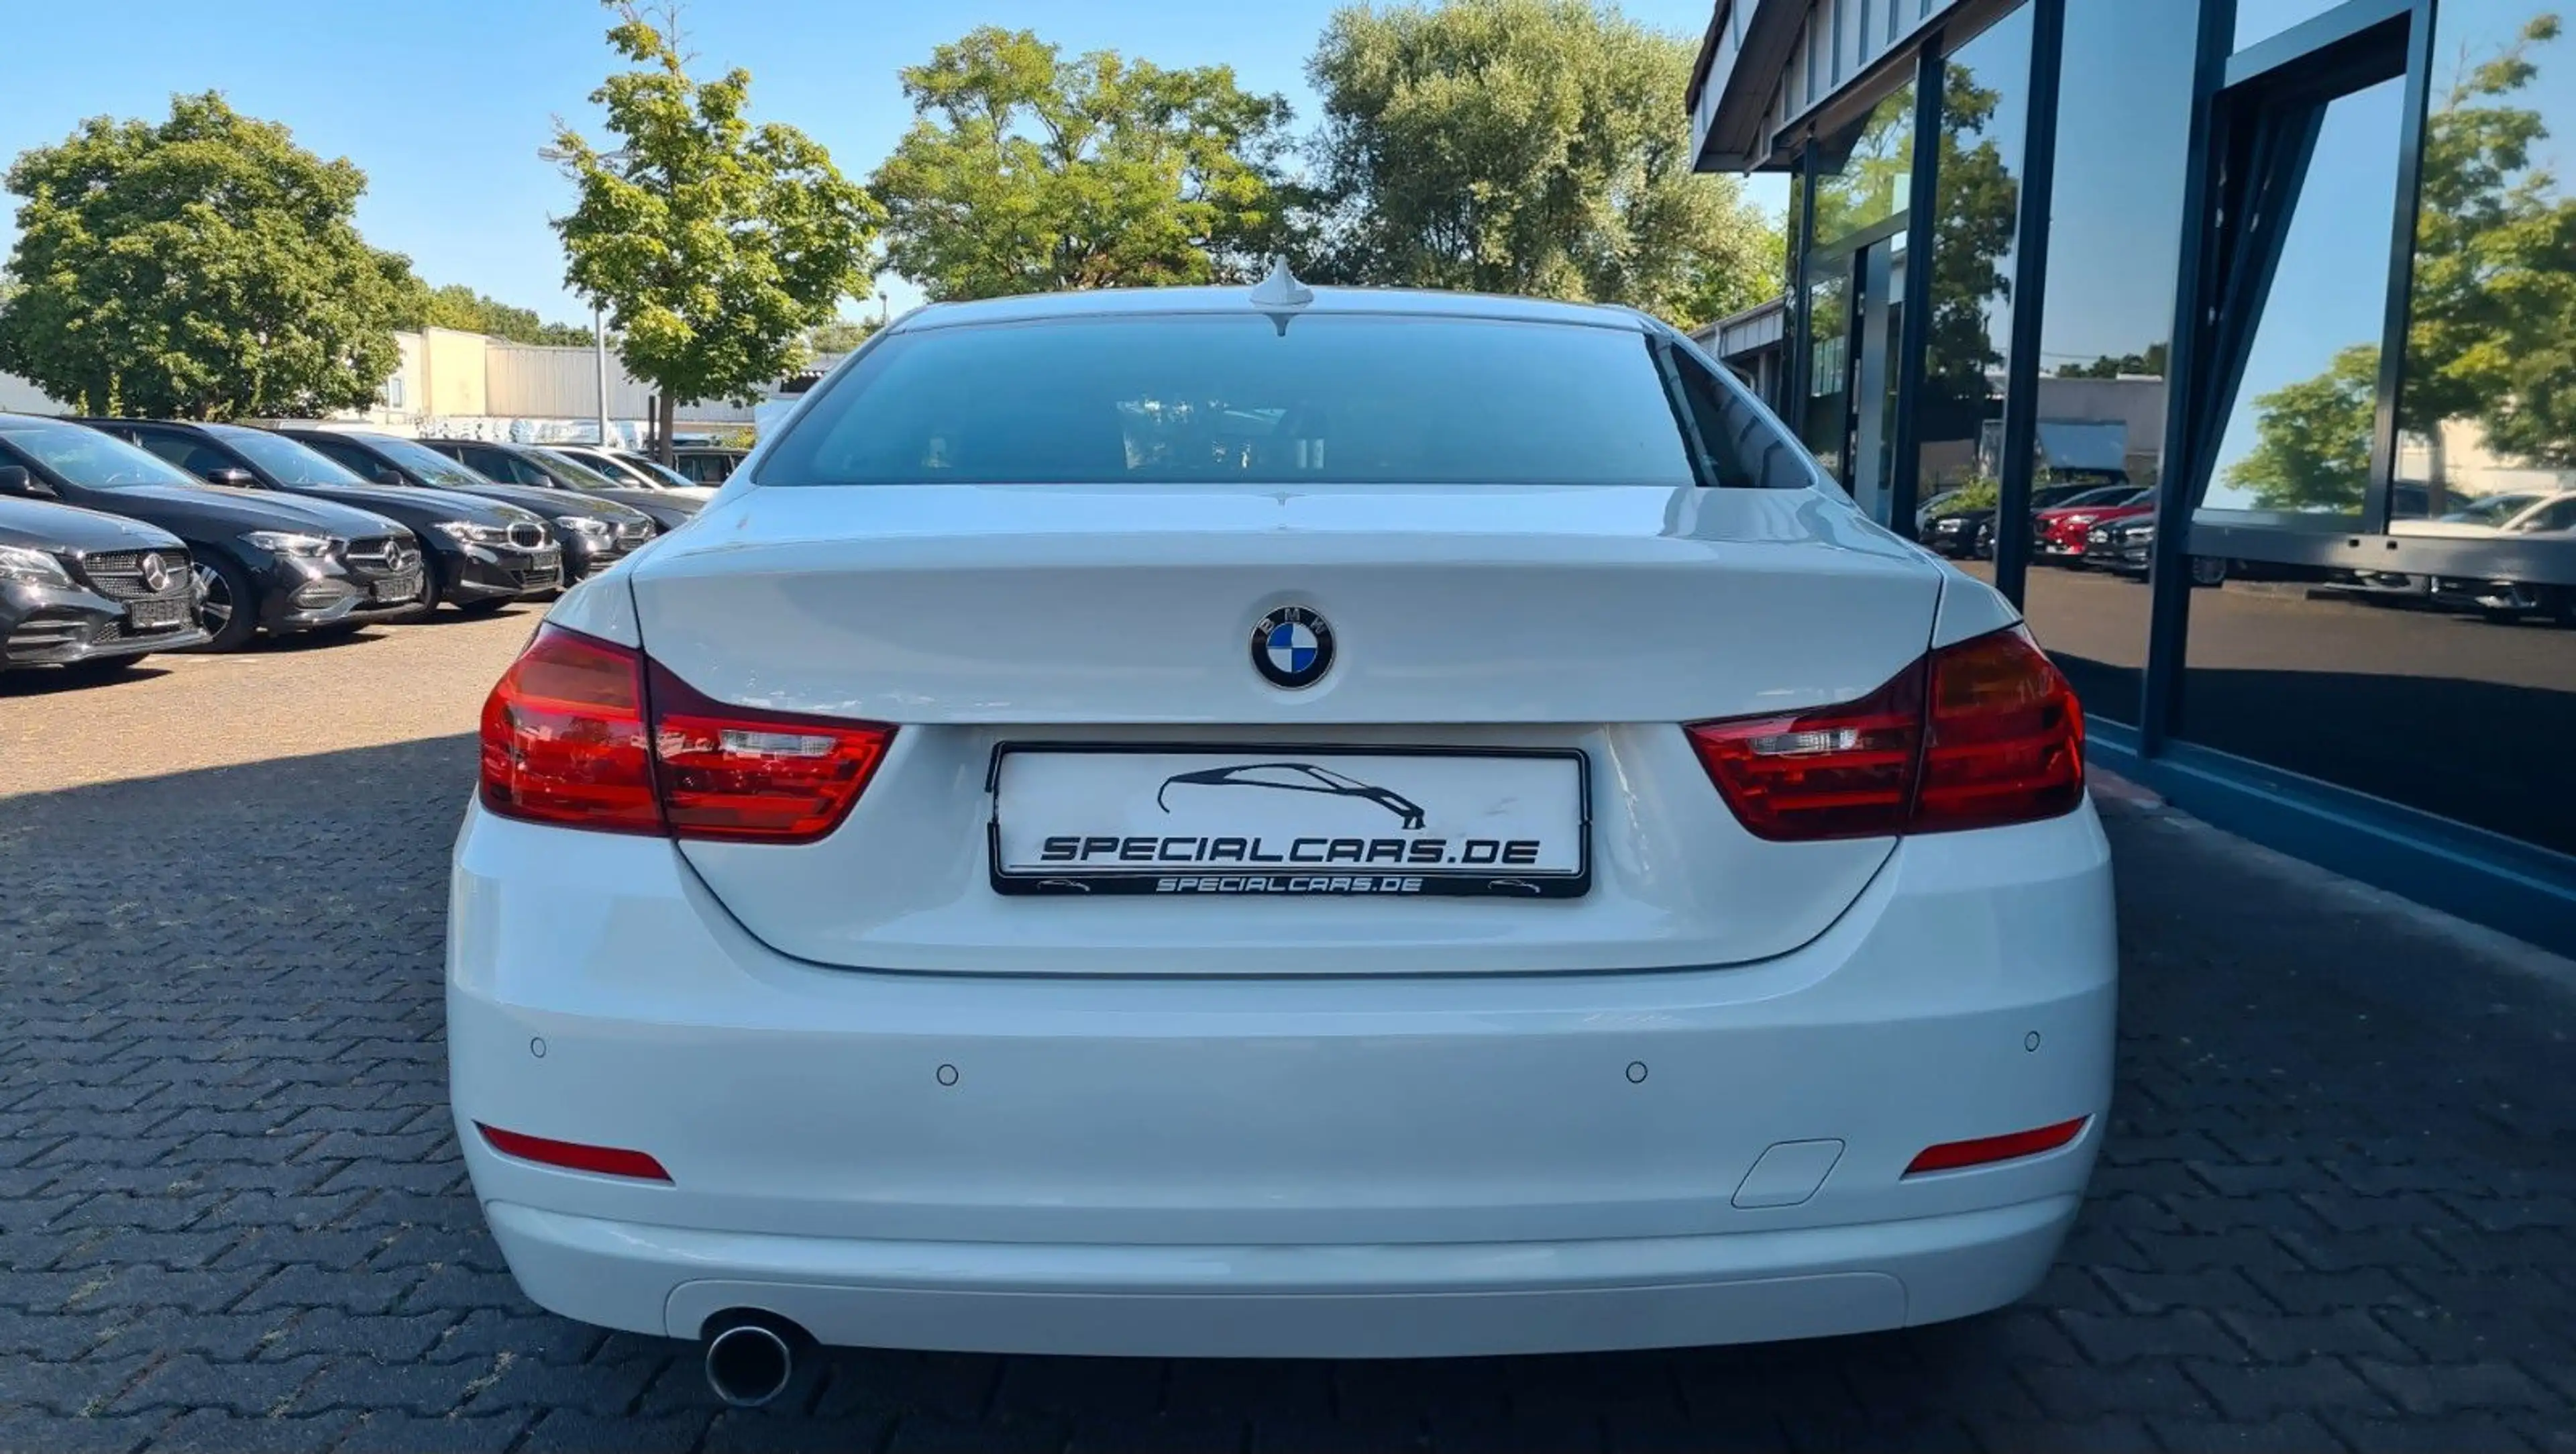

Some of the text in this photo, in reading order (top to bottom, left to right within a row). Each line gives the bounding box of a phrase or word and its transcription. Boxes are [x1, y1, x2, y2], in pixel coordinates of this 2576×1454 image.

[1258, 608, 1326, 635] BMW
[1040, 837, 1540, 864] SPECIALCARS.DE
[1155, 877, 1423, 892] SPECIALCARS.DE
